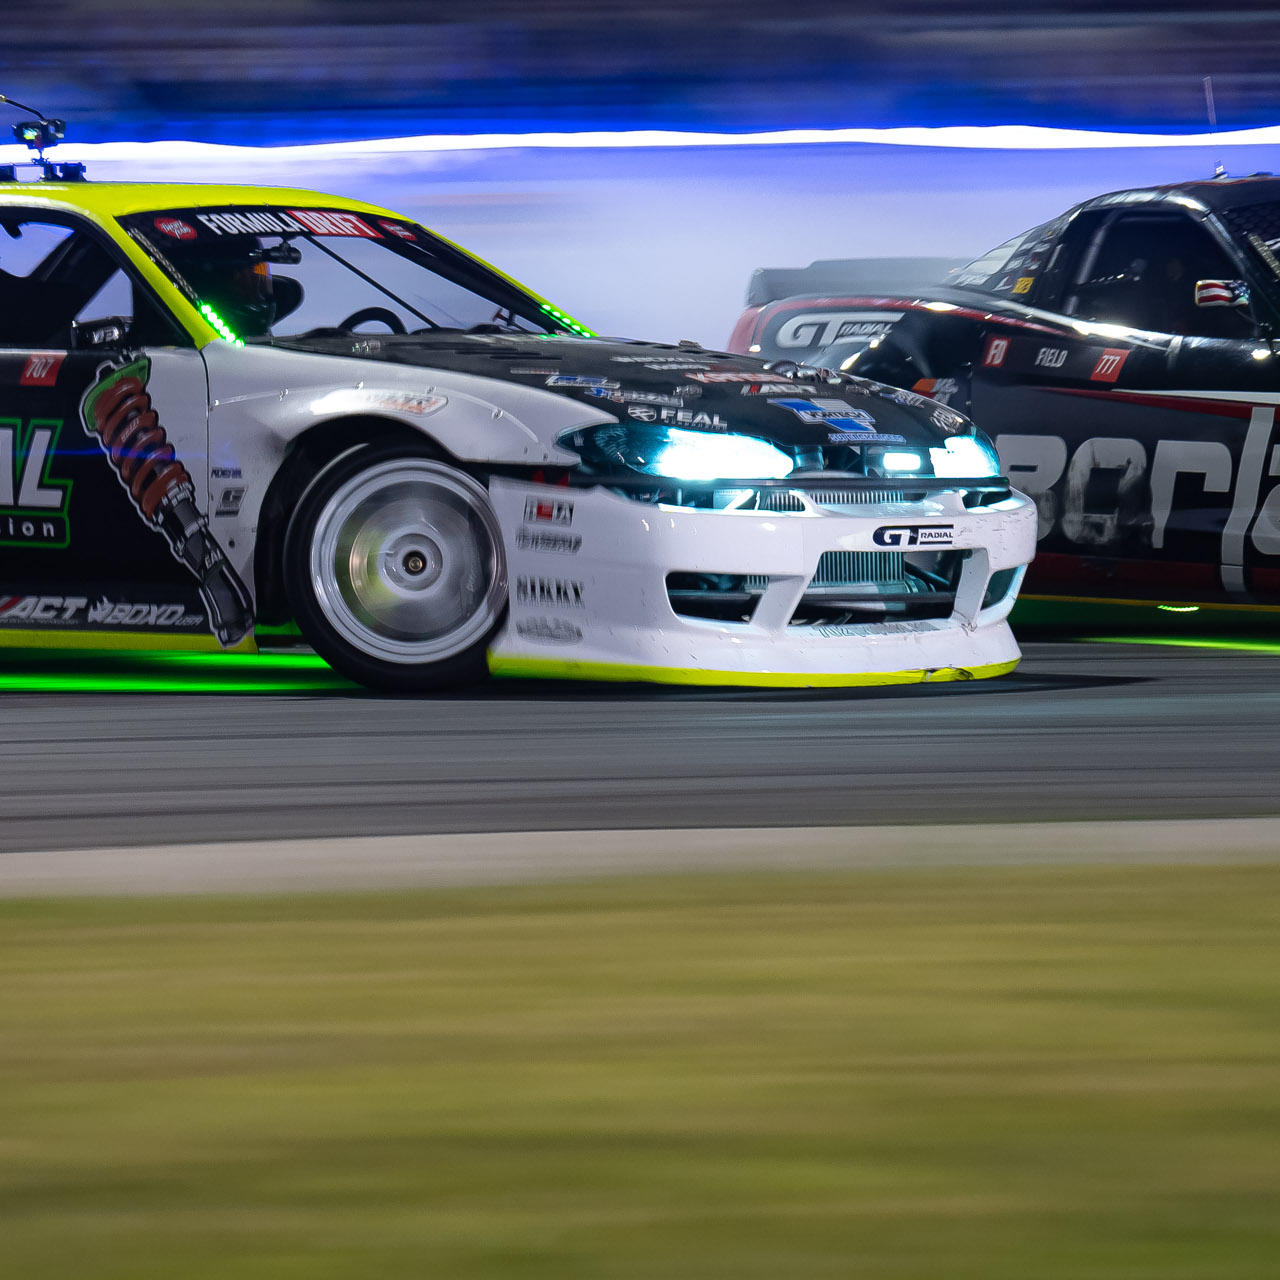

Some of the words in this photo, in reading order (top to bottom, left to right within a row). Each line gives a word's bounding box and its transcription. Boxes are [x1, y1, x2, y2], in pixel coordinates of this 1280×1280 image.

[196, 212, 309, 236] FORMULA
[290, 210, 378, 238] DRIFT
[838, 321, 893, 337] RADIAL
[25, 355, 55, 378] 707
[1034, 347, 1069, 368] FIELD
[1095, 354, 1121, 375] 777
[660, 407, 728, 428] FEAL
[872, 524, 924, 547] GT
